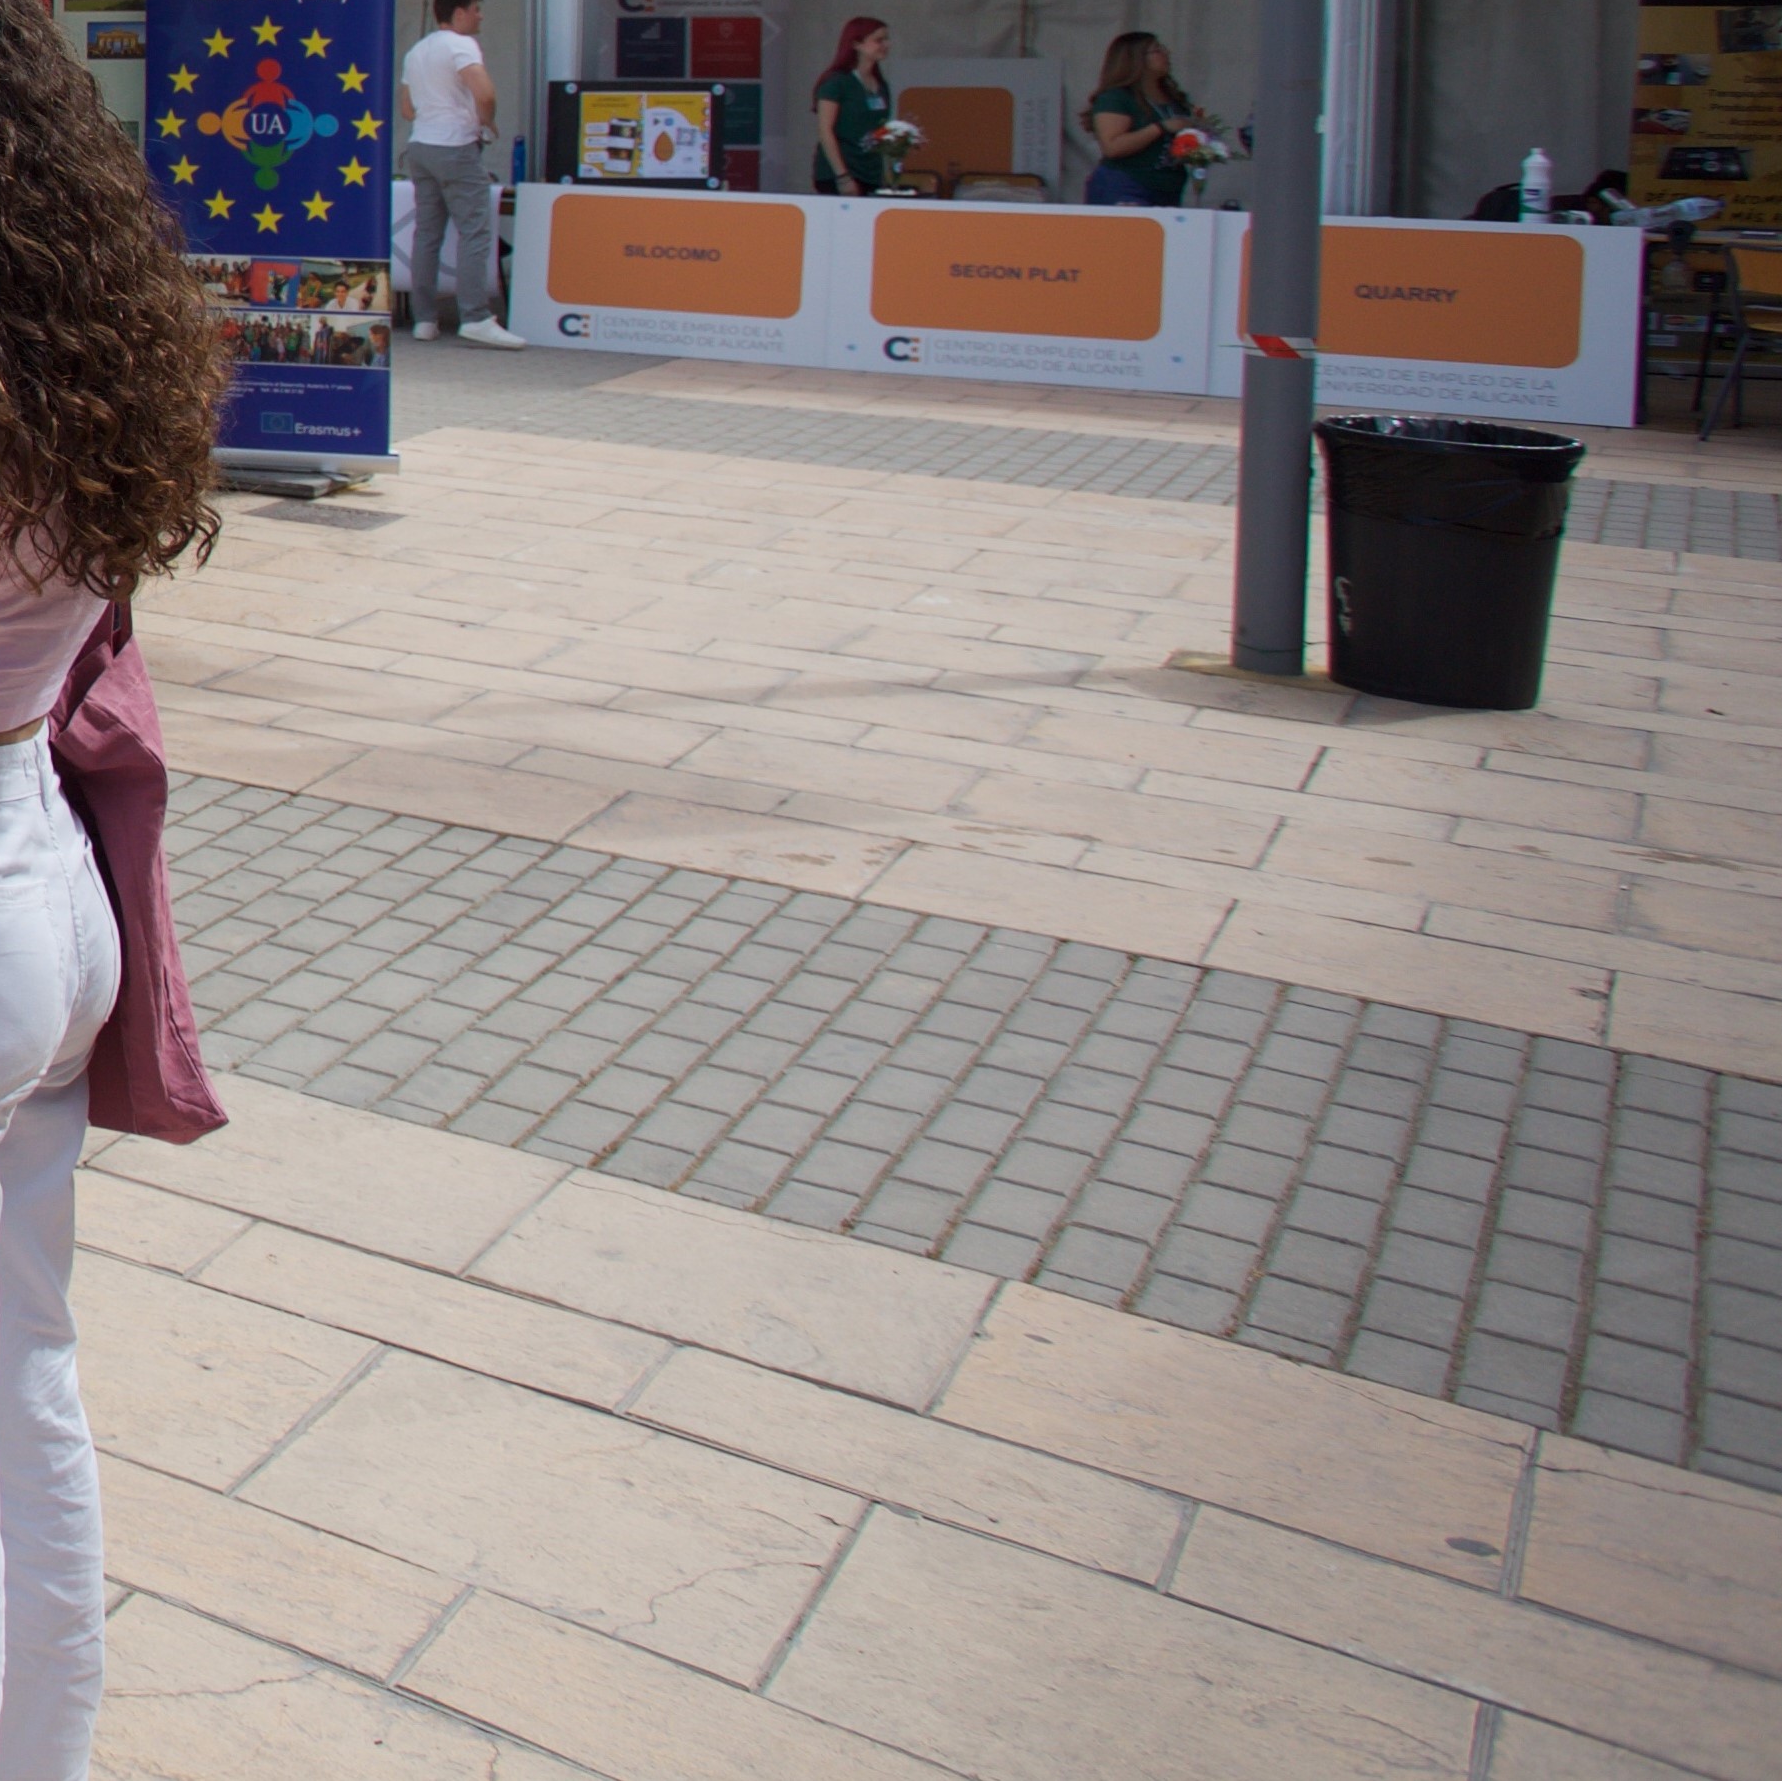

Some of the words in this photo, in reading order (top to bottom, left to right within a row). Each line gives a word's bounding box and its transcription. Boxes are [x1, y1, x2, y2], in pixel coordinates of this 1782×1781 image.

[251, 114, 285, 134] UA
[624, 245, 721, 262] SILOCOMO
[950, 263, 1021, 280] SEGON
[1029, 268, 1080, 282] PLAT
[1354, 284, 1458, 303] QUARRY
[1389, 369, 1412, 381] DE
[1418, 371, 1494, 386] EMPLEO
[1500, 376, 1526, 388] DE
[1531, 378, 1555, 390] LA
[1439, 387, 1463, 399] DE
[1468, 390, 1558, 407] ALICANTE
